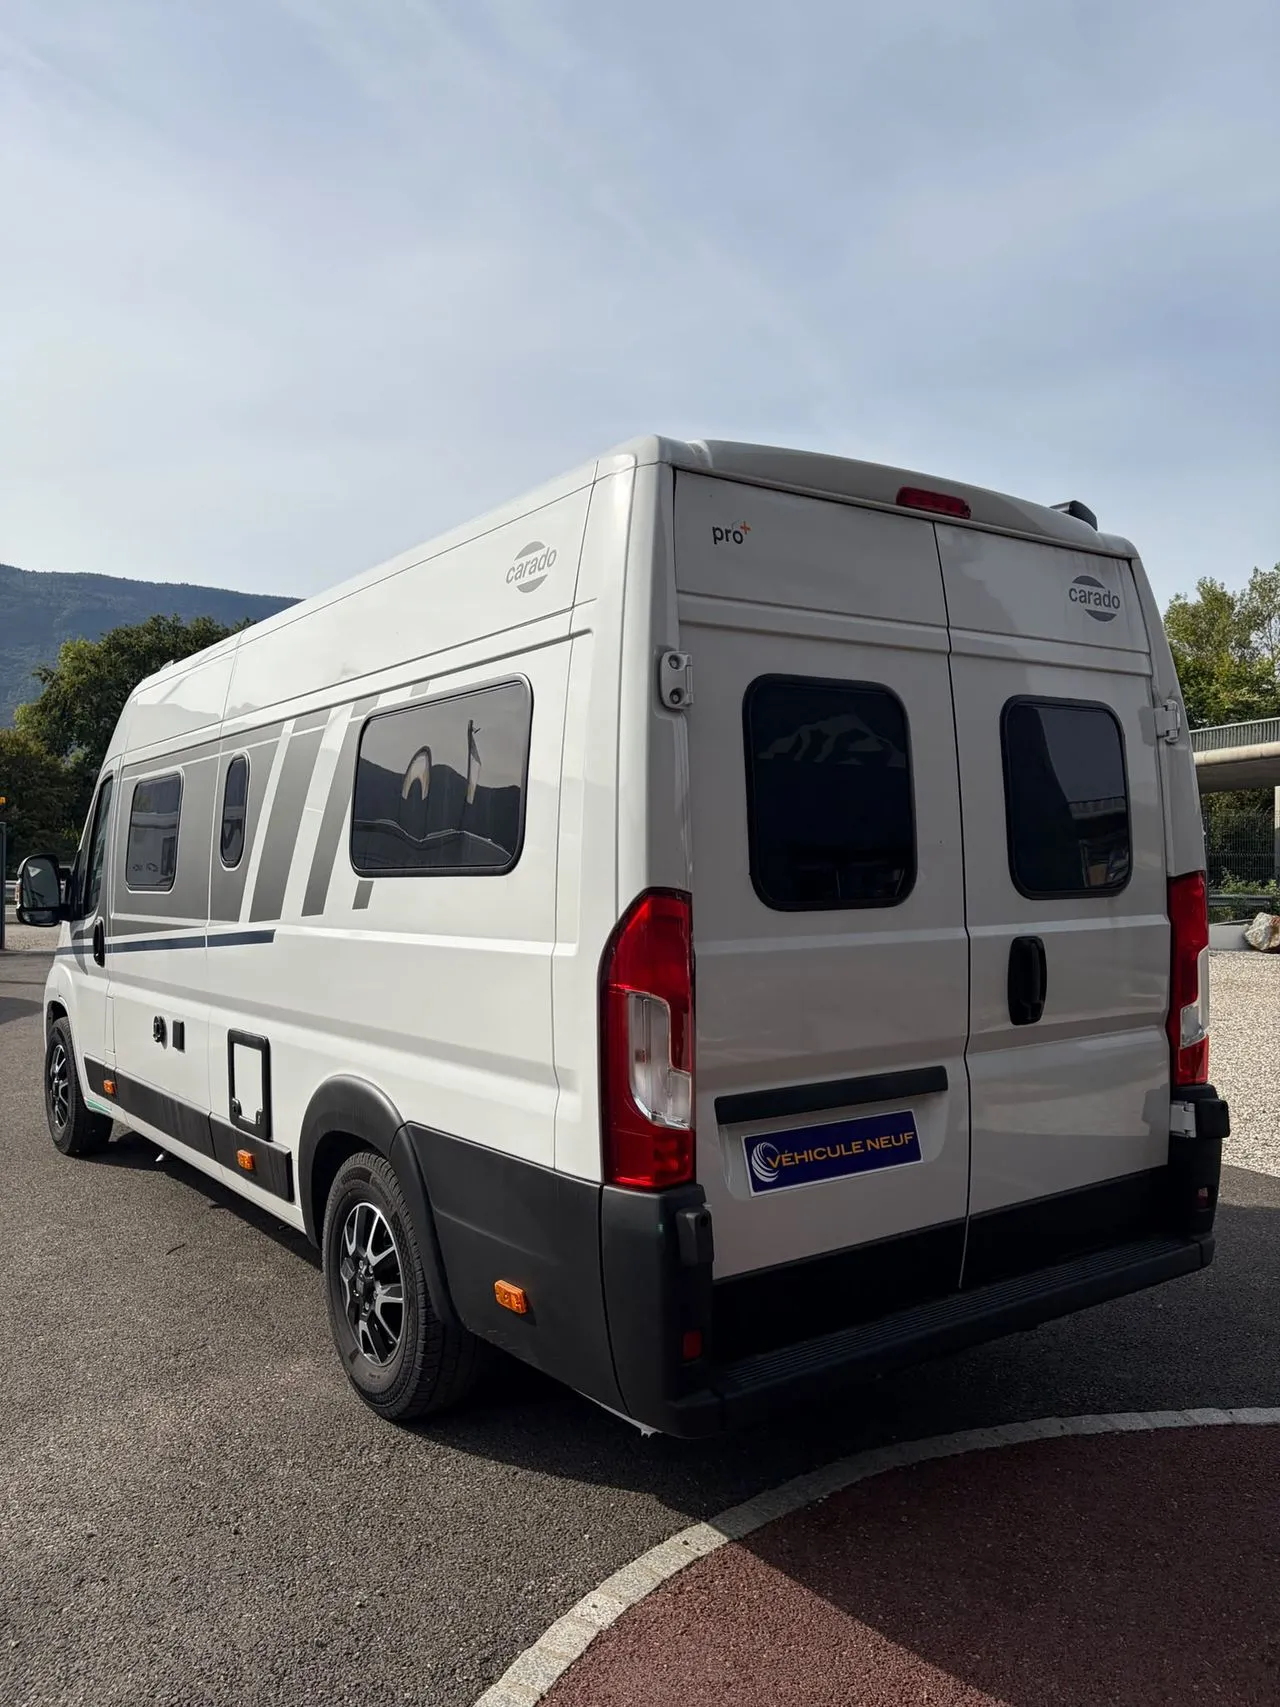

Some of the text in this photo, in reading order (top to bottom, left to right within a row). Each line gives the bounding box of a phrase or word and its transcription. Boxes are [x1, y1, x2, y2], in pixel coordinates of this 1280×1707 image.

[505, 547, 557, 584] carado
[1068, 588, 1120, 609] carado
[766, 1131, 914, 1169] VÉHICULE NEUF
